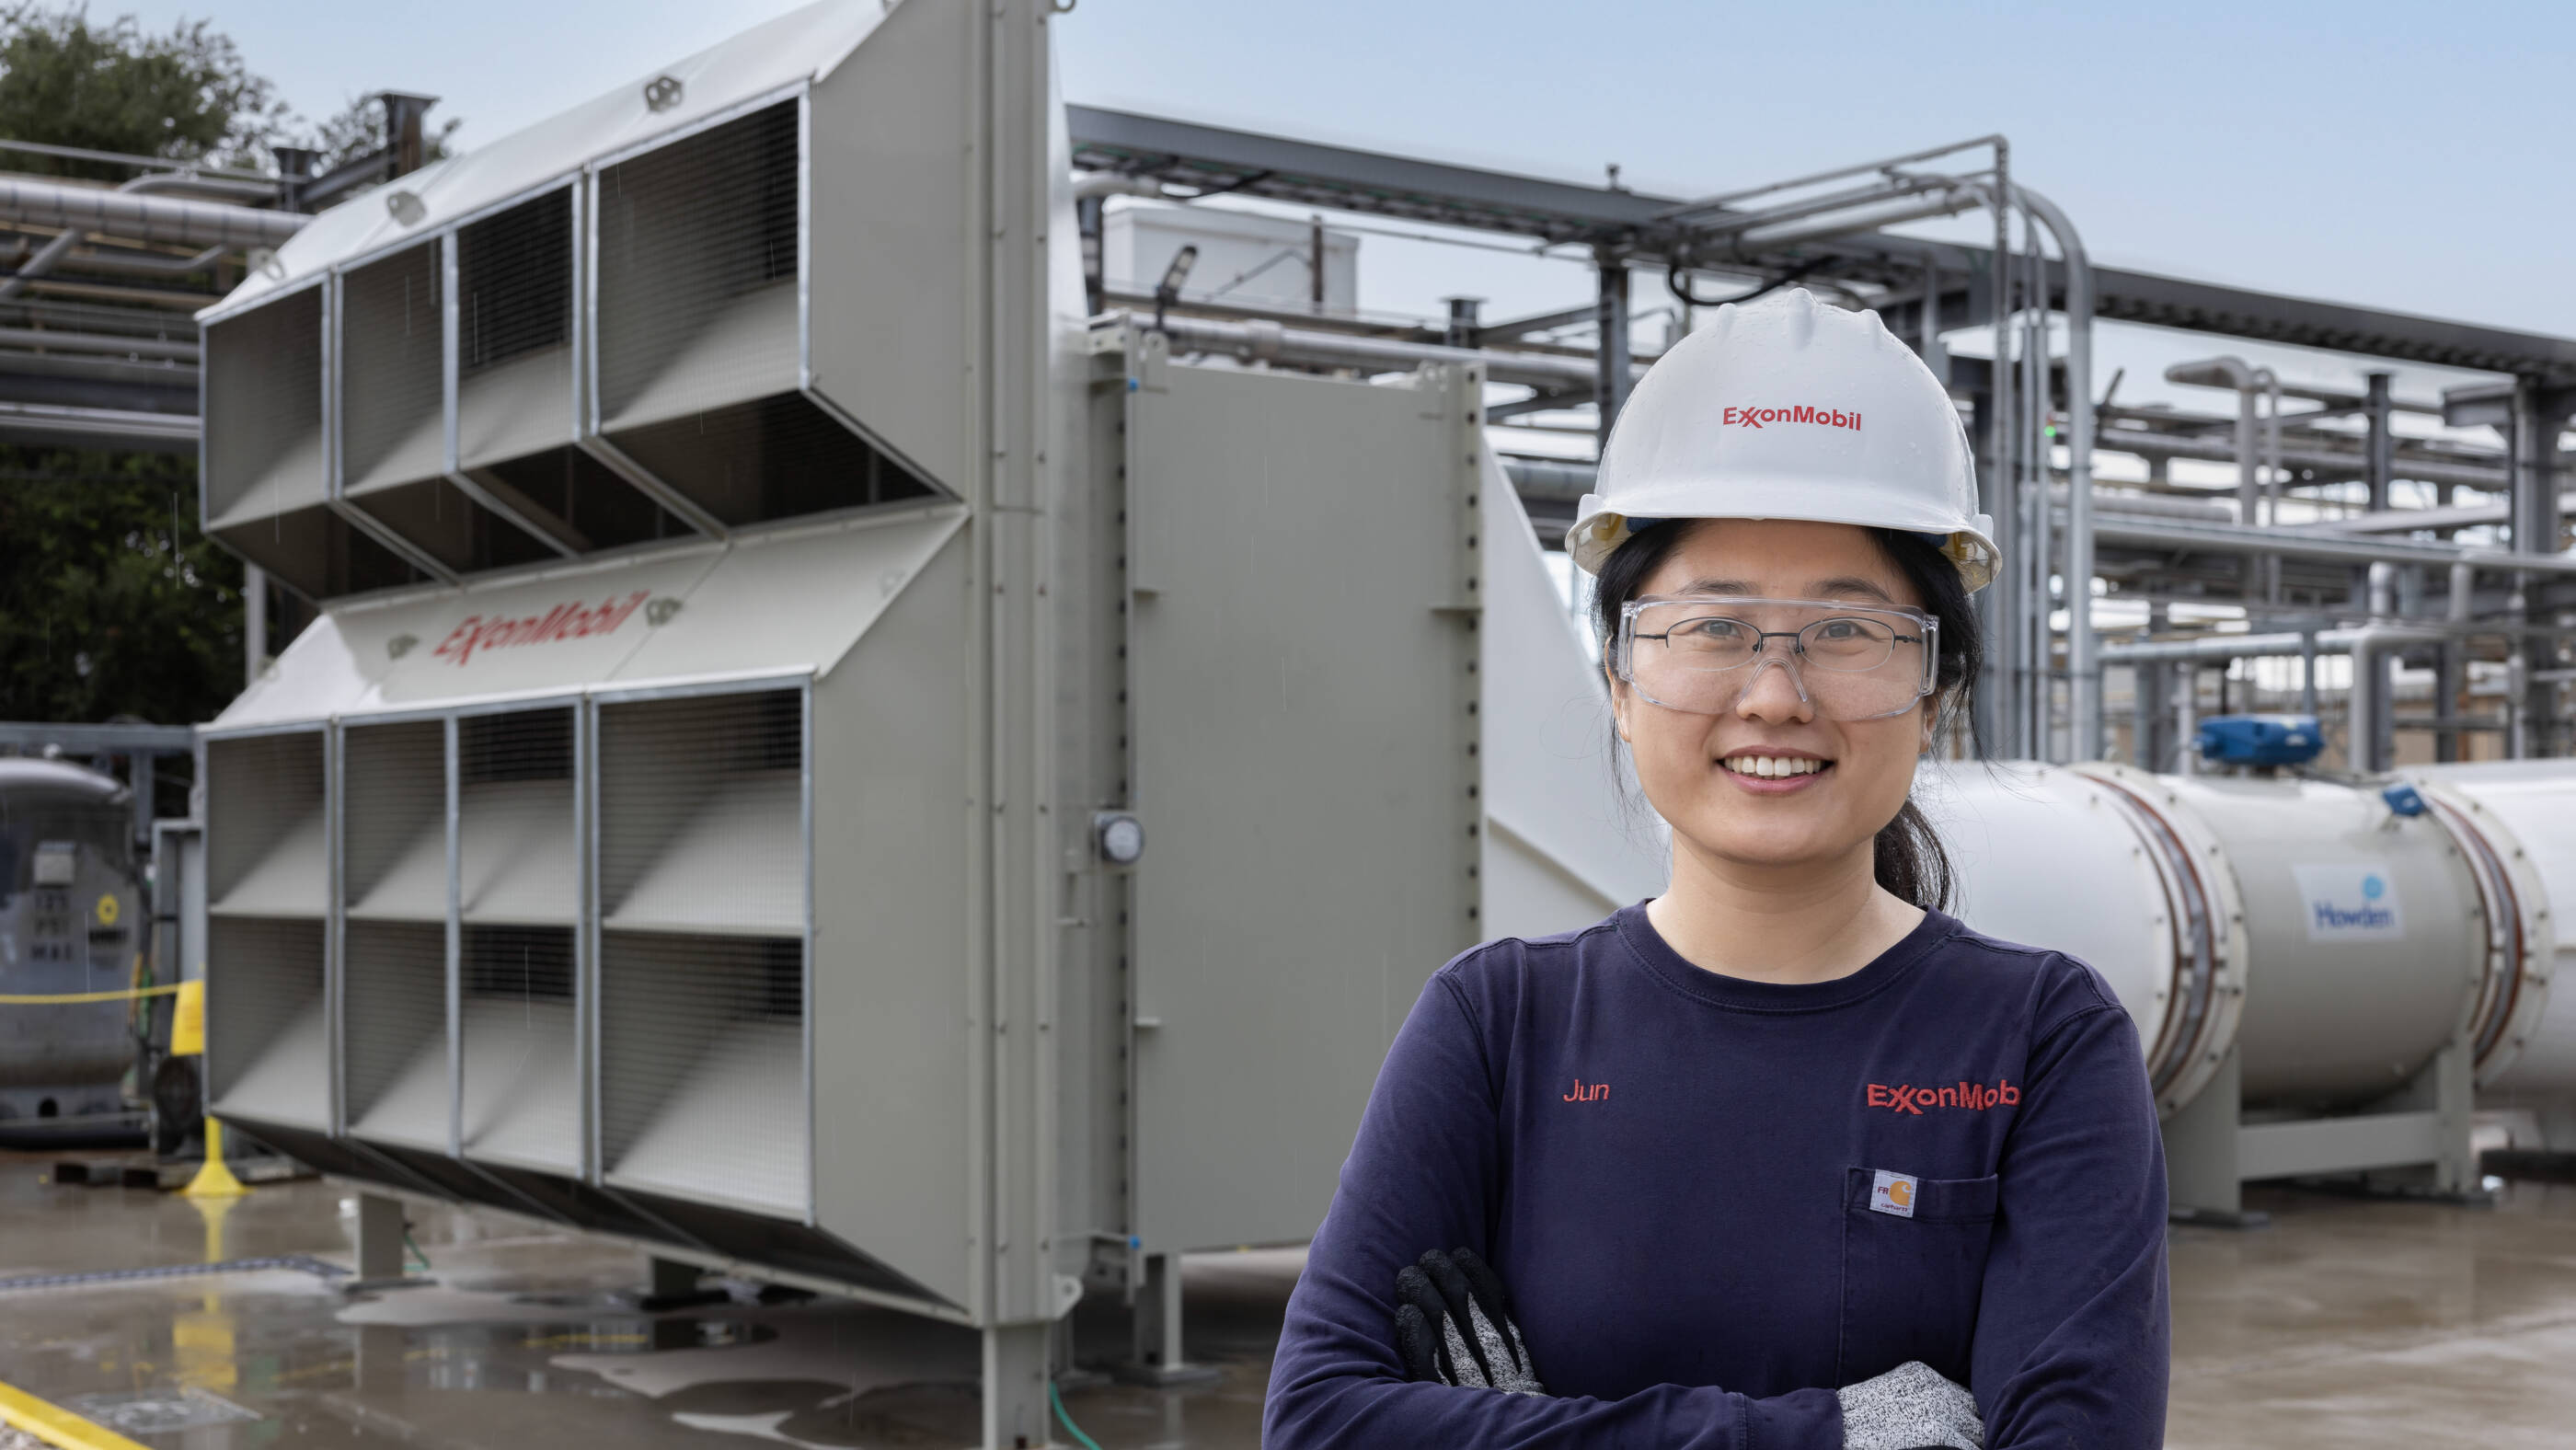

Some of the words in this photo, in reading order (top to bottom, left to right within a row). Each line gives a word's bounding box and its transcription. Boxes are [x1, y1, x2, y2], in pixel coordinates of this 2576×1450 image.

[1723, 405, 1861, 431] ExxonMobil
[432, 590, 650, 666] ExxonMobil
[2314, 901, 2394, 929] Howden
[1563, 1078, 1610, 1102] Jun
[1867, 1079, 2021, 1115] ExxonMob
[1878, 1186, 1889, 1194] FR
